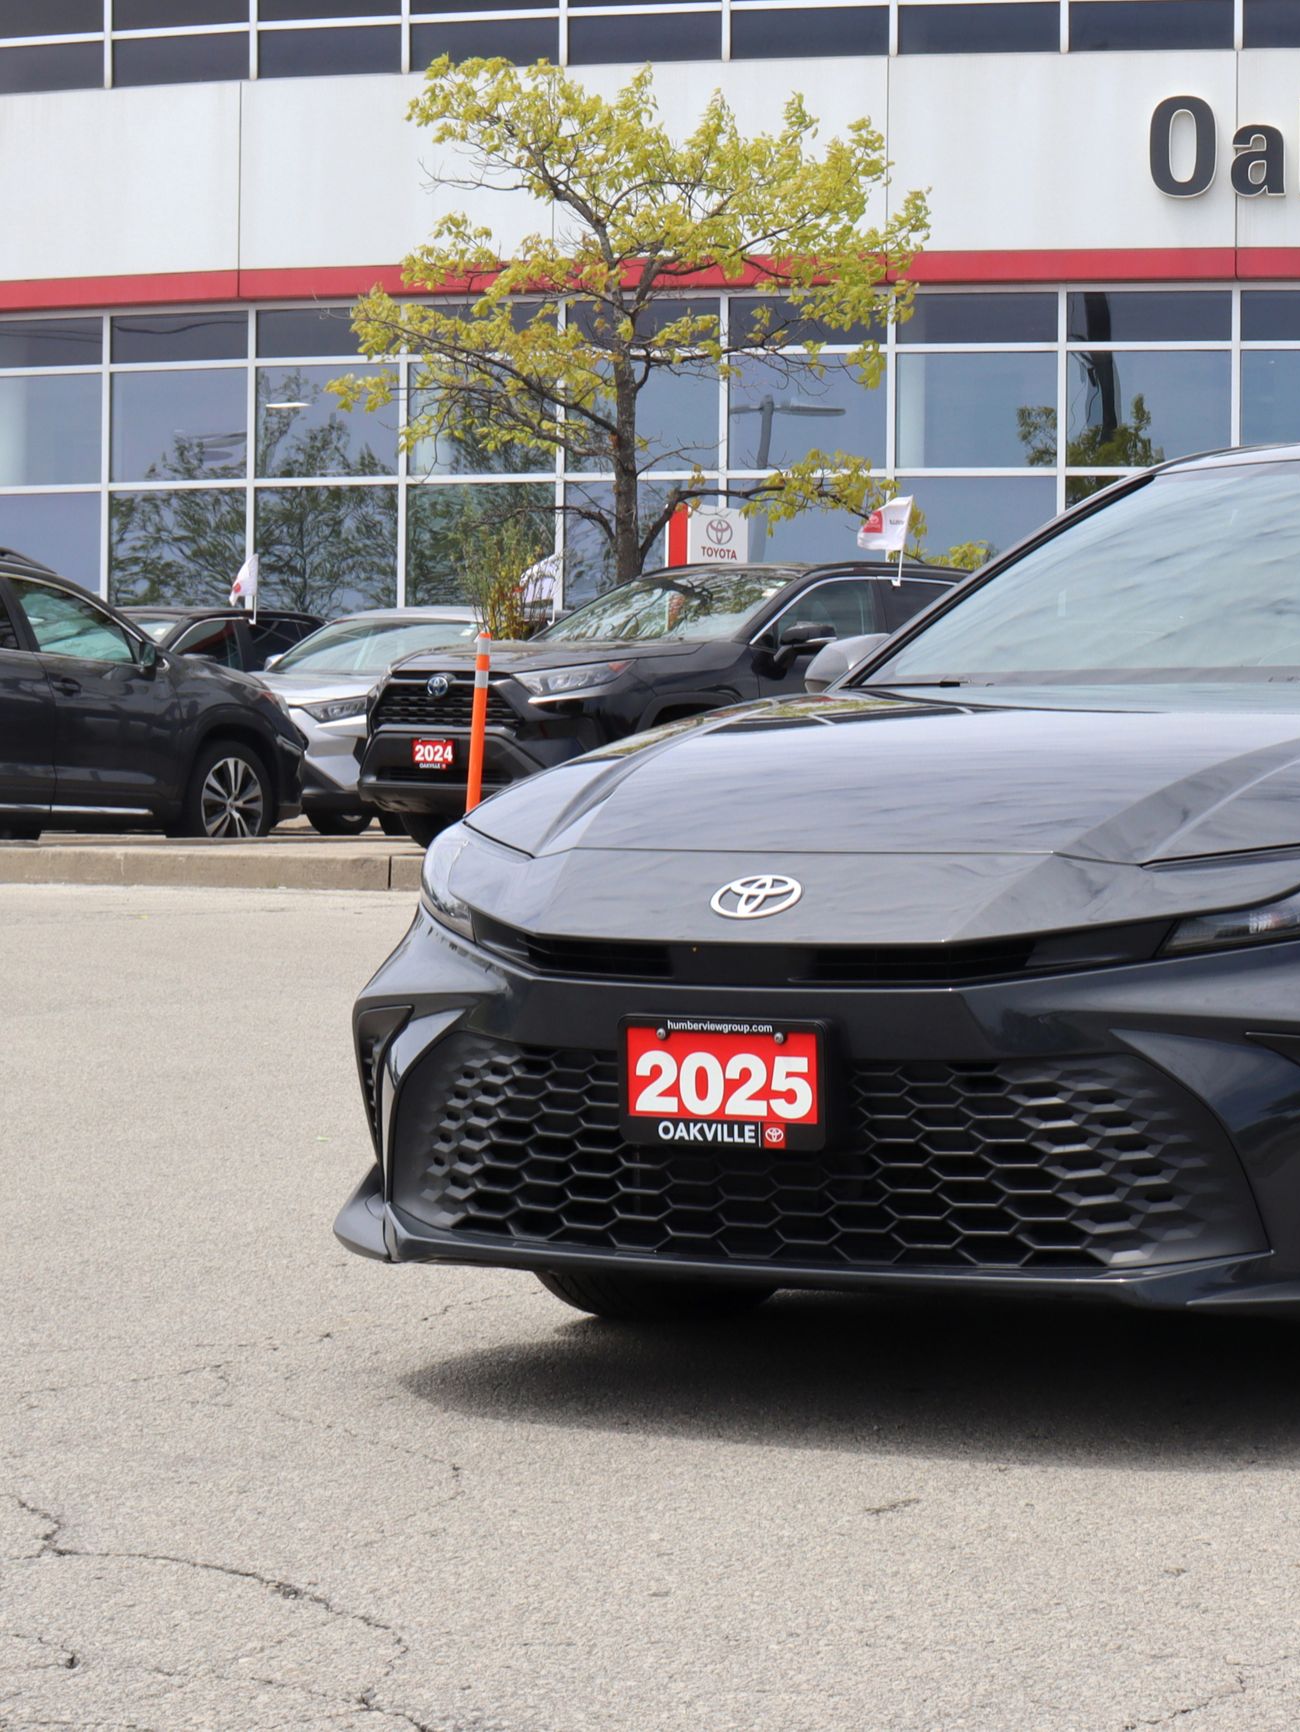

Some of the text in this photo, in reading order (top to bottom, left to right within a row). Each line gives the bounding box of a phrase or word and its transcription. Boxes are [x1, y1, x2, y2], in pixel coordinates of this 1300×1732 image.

[700, 546, 737, 561] TOYOTA
[415, 744, 453, 762] 2024
[667, 1019, 773, 1034] humberviewgroup.com
[635, 1049, 813, 1120] 2025
[657, 1120, 756, 1144] OAKVILLE
